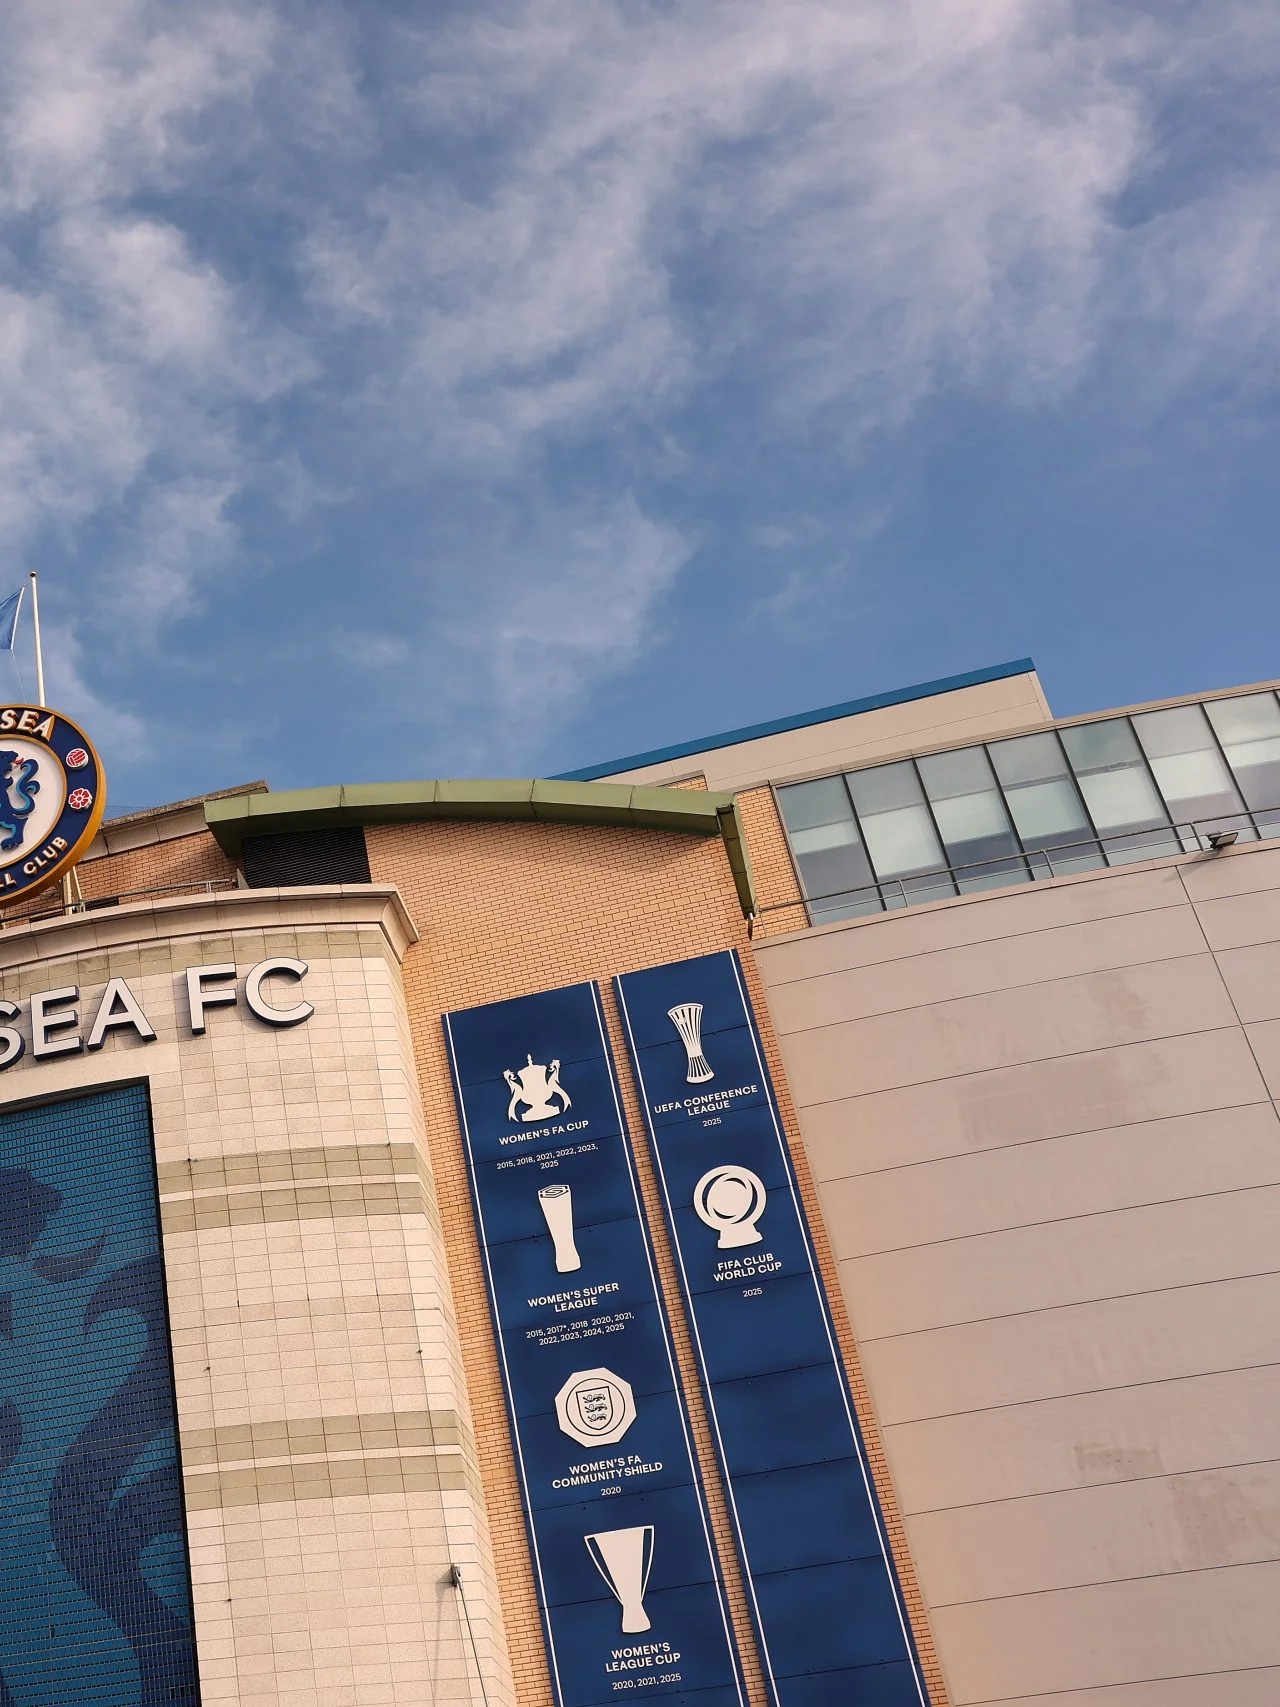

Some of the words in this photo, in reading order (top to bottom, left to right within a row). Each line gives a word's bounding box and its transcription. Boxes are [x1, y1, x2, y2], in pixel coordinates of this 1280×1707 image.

[23, 836, 69, 875] CLUB
[186, 956, 316, 1035] FC
[654, 1101, 682, 1114] UEFA
[683, 1085, 758, 1107] CONFERENCE
[687, 1101, 731, 1116] LEAGUE
[702, 1117, 722, 1127] 2025
[498, 1128, 550, 1146] WOMEN'S
[552, 1126, 565, 1135] FA
[566, 1120, 589, 1131] CUP
[496, 1161, 516, 1169] 2015,
[516, 1157, 536, 1166] 2018,
[536, 1153, 555, 1162] 2021,
[556, 1148, 577, 1158] 2022,
[577, 1143, 599, 1153] 2023,
[540, 1160, 559, 1170] 2025
[713, 1267, 755, 1282] WORLD
[757, 1262, 783, 1276] CUP
[717, 1259, 741, 1272] FIFA
[743, 1252, 774, 1266] CLUB
[527, 1290, 581, 1308] WOMEN'S
[583, 1282, 620, 1297] SUPER
[742, 1287, 763, 1298] 2025
[554, 1297, 598, 1313] LEAGUE
[525, 1329, 546, 1339] 2015,
[591, 1316, 613, 1326] 2020,
[614, 1311, 635, 1322] 2021,
[538, 1336, 560, 1346] 2022,
[560, 1332, 582, 1342] 2023,
[582, 1327, 604, 1337] 2024,
[605, 1323, 625, 1333] 2025
[569, 1457, 625, 1475] WOMEN'S
[627, 1455, 642, 1465] FA
[552, 1468, 623, 1489] COMMUNITY
[624, 1462, 663, 1476] SHIELD
[600, 1485, 622, 1496] 2020
[611, 1642, 671, 1660] WOMEN'S
[605, 1656, 653, 1673] LEAGUE
[655, 1652, 681, 1665] CUP
[611, 1680, 636, 1690] 2020,
[637, 1676, 659, 1687] 2021,
[659, 1673, 682, 1684] 2025
